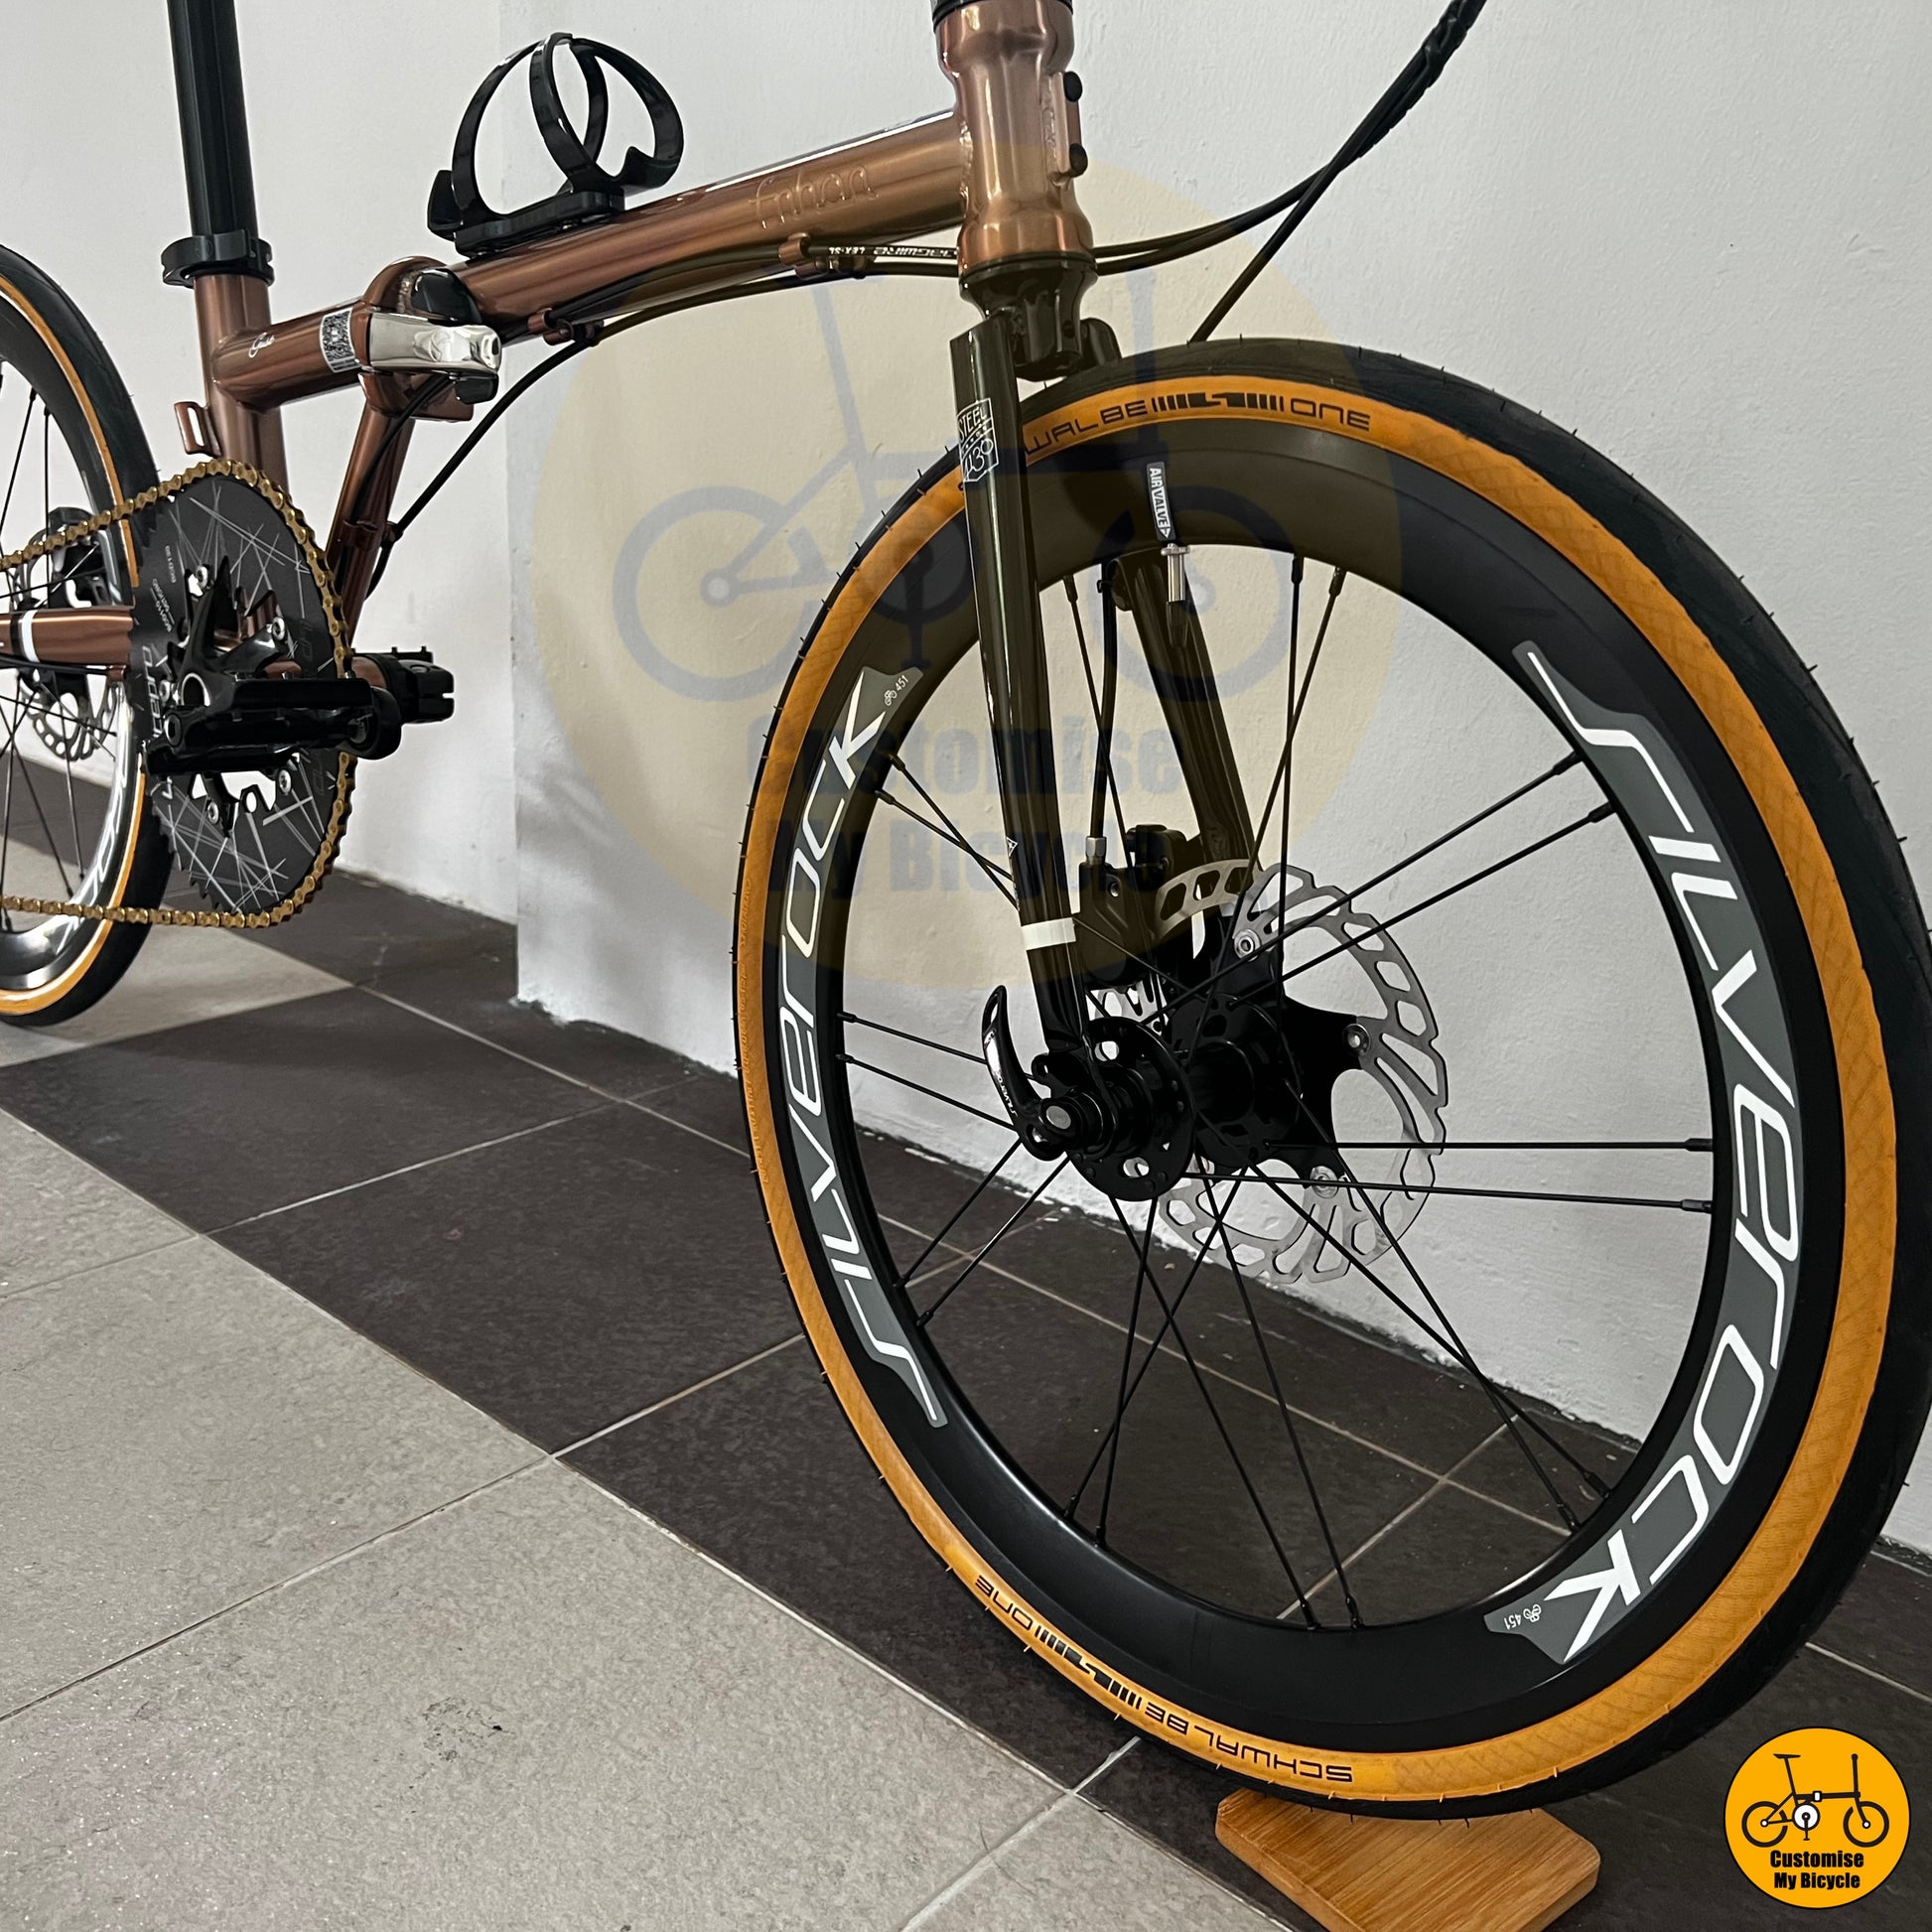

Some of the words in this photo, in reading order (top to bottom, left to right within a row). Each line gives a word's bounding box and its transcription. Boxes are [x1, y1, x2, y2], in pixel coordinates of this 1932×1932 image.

[958, 405, 987, 444] STEEL
[1290, 398, 1371, 432] ONE
[1150, 467, 1165, 488] AIR
[1154, 489, 1170, 527] VALVE
[895, 674, 909, 692] 451
[975, 1575, 1034, 1631] ONE
[1503, 1613, 1522, 1630] 451
[1144, 1701, 1353, 1783] SCHWALBE
